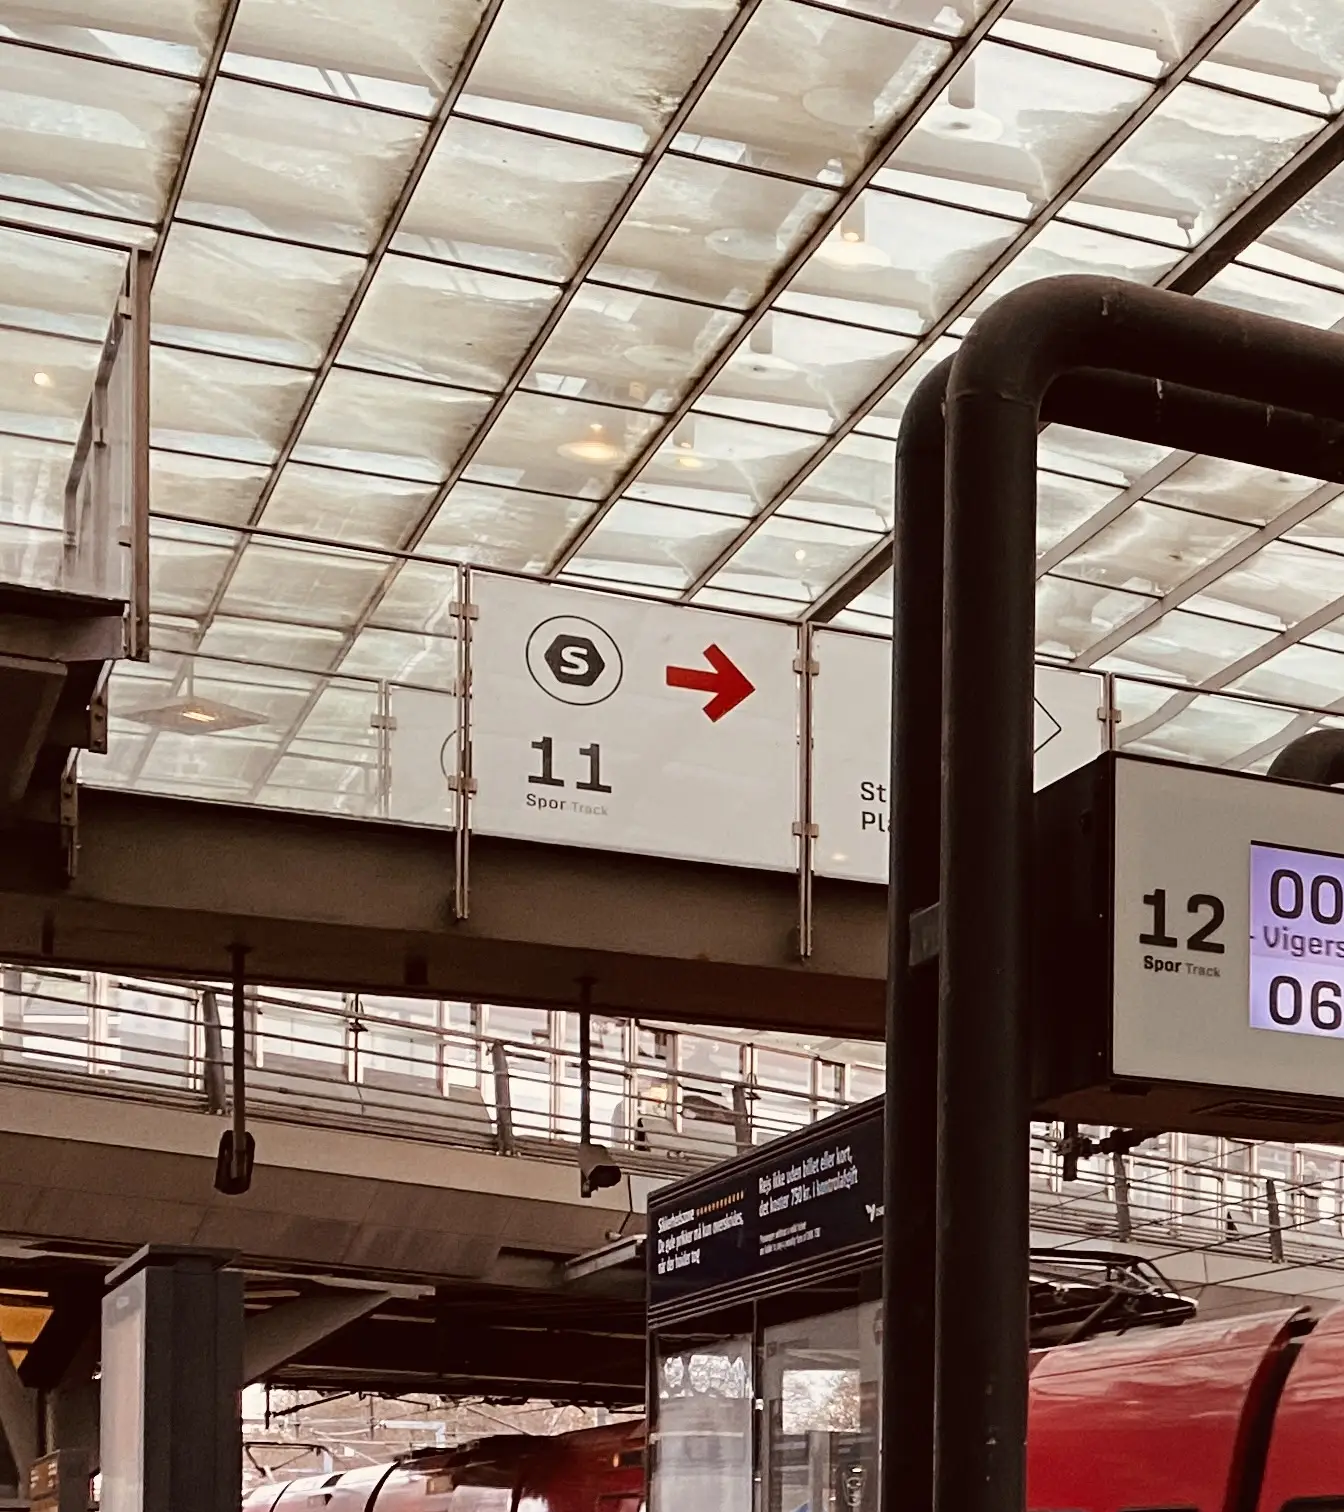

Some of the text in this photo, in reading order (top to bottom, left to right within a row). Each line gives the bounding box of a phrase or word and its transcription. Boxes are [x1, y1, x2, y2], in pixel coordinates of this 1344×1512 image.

[527, 736, 612, 793] 11
[526, 793, 609, 816] Spor Track
[861, 811, 891, 833] Pl
[1139, 888, 1225, 954] 12
[1269, 868, 1344, 925] 00
[1143, 955, 1221, 978] Spor Track
[1268, 974, 1343, 1031] 06
